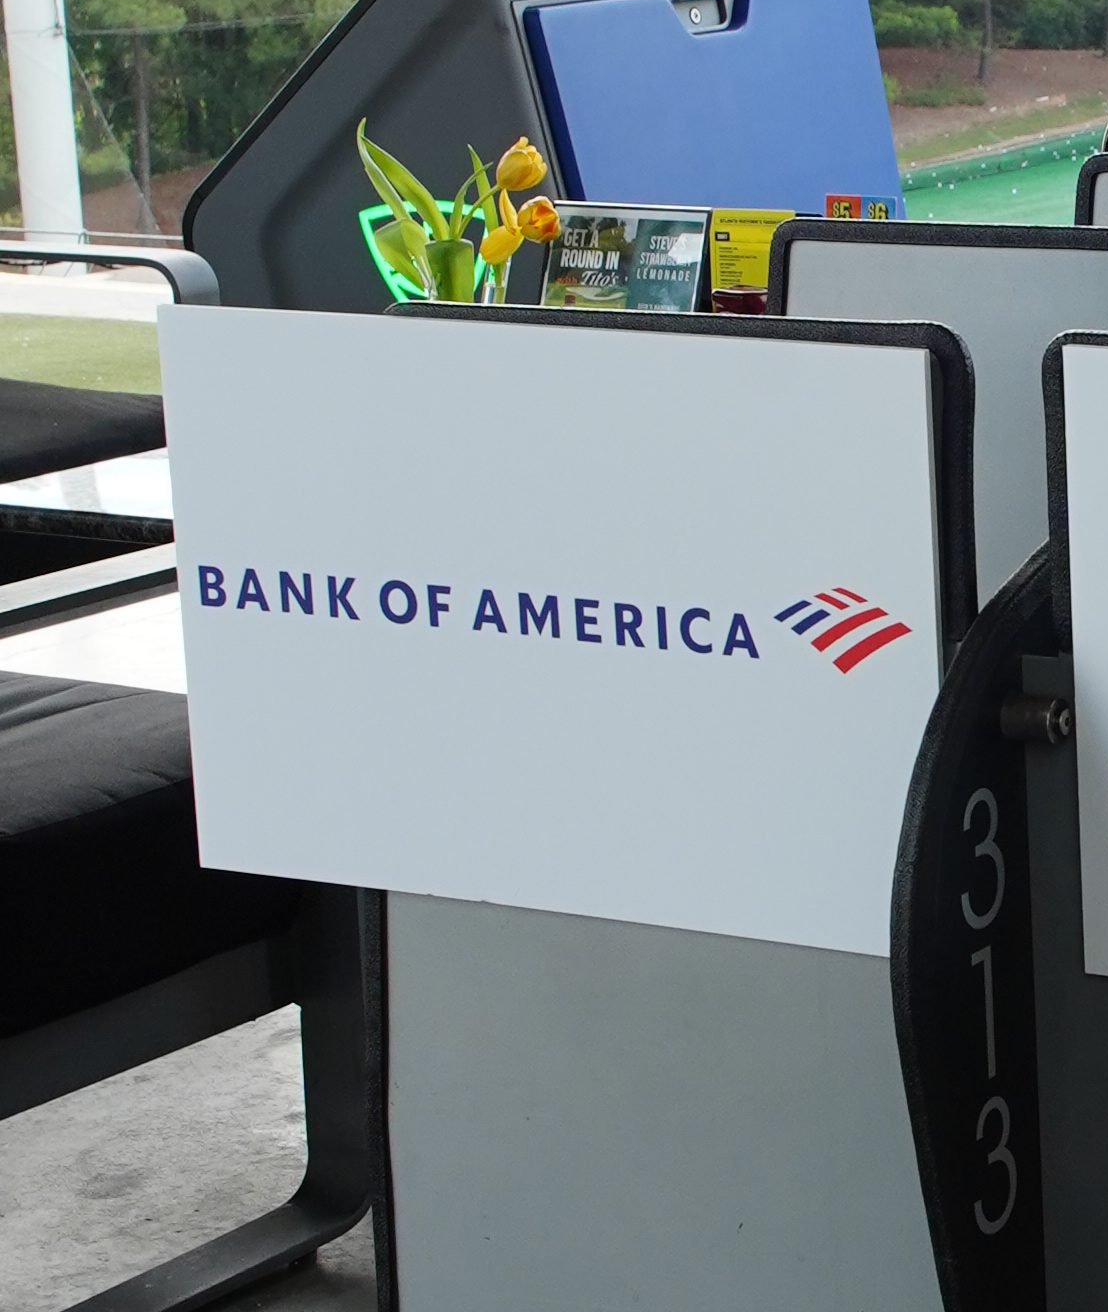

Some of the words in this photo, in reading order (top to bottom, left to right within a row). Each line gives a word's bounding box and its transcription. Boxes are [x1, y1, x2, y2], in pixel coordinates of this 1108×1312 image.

[832, 201, 850, 218] $5
[867, 201, 886, 219] $6
[563, 229, 588, 247] GET
[590, 230, 599, 248] A
[560, 249, 603, 268] ROUND
[605, 251, 620, 270] IN
[580, 270, 619, 288] Tito's
[636, 268, 690, 281] LEMONADE
[198, 564, 361, 622] BANK
[378, 578, 452, 628] OF
[471, 588, 761, 659] AMERICA
